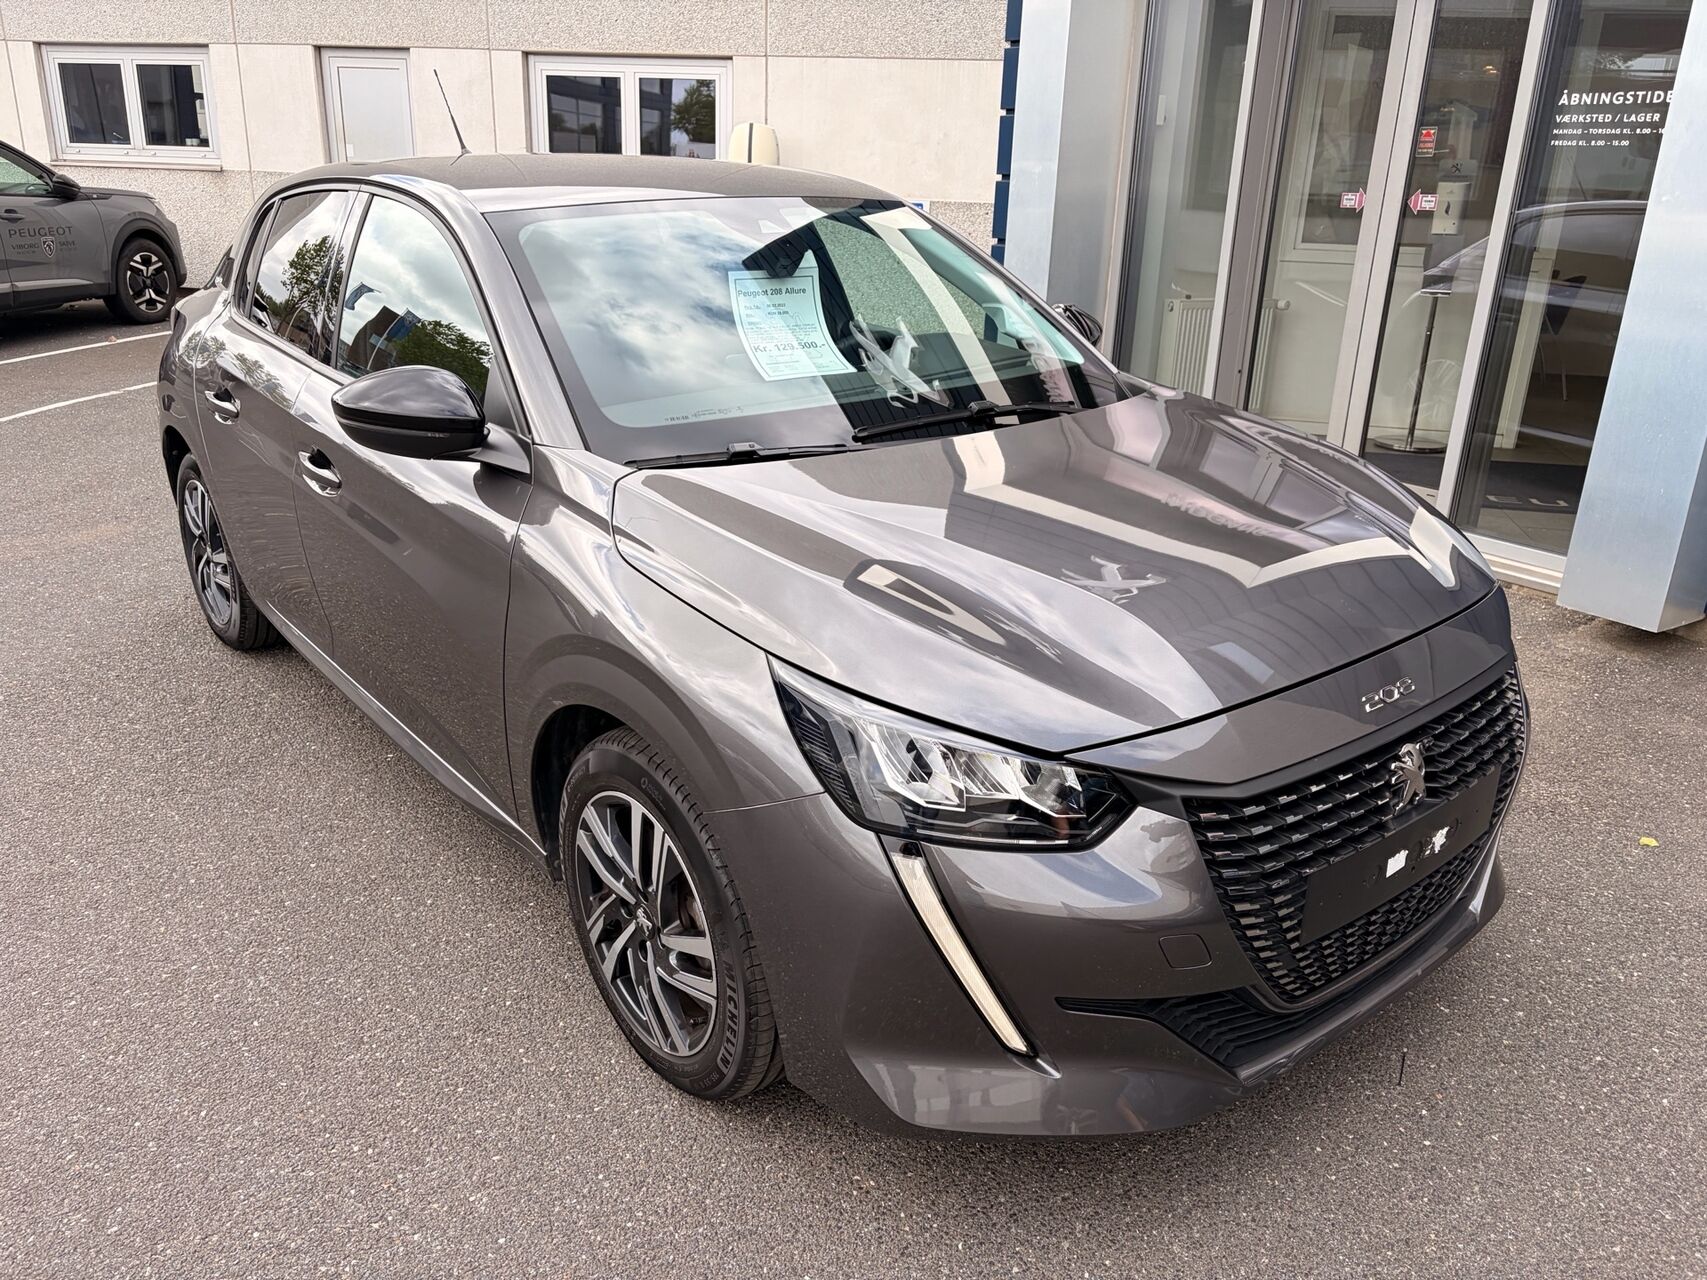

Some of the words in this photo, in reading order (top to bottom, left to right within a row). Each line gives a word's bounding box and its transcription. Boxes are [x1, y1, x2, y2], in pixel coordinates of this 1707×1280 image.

[1555, 114, 1612, 123] VÆRKSTED
[1623, 113, 1661, 122] LAGER
[8, 226, 73, 238] PEUGEOT
[737, 288, 769, 298] Peugeot
[770, 288, 783, 296] 208
[784, 287, 807, 295] Allure
[753, 344, 772, 353] Kr.
[1361, 676, 1416, 713] 208
[720, 960, 739, 1070] MICHELIN
